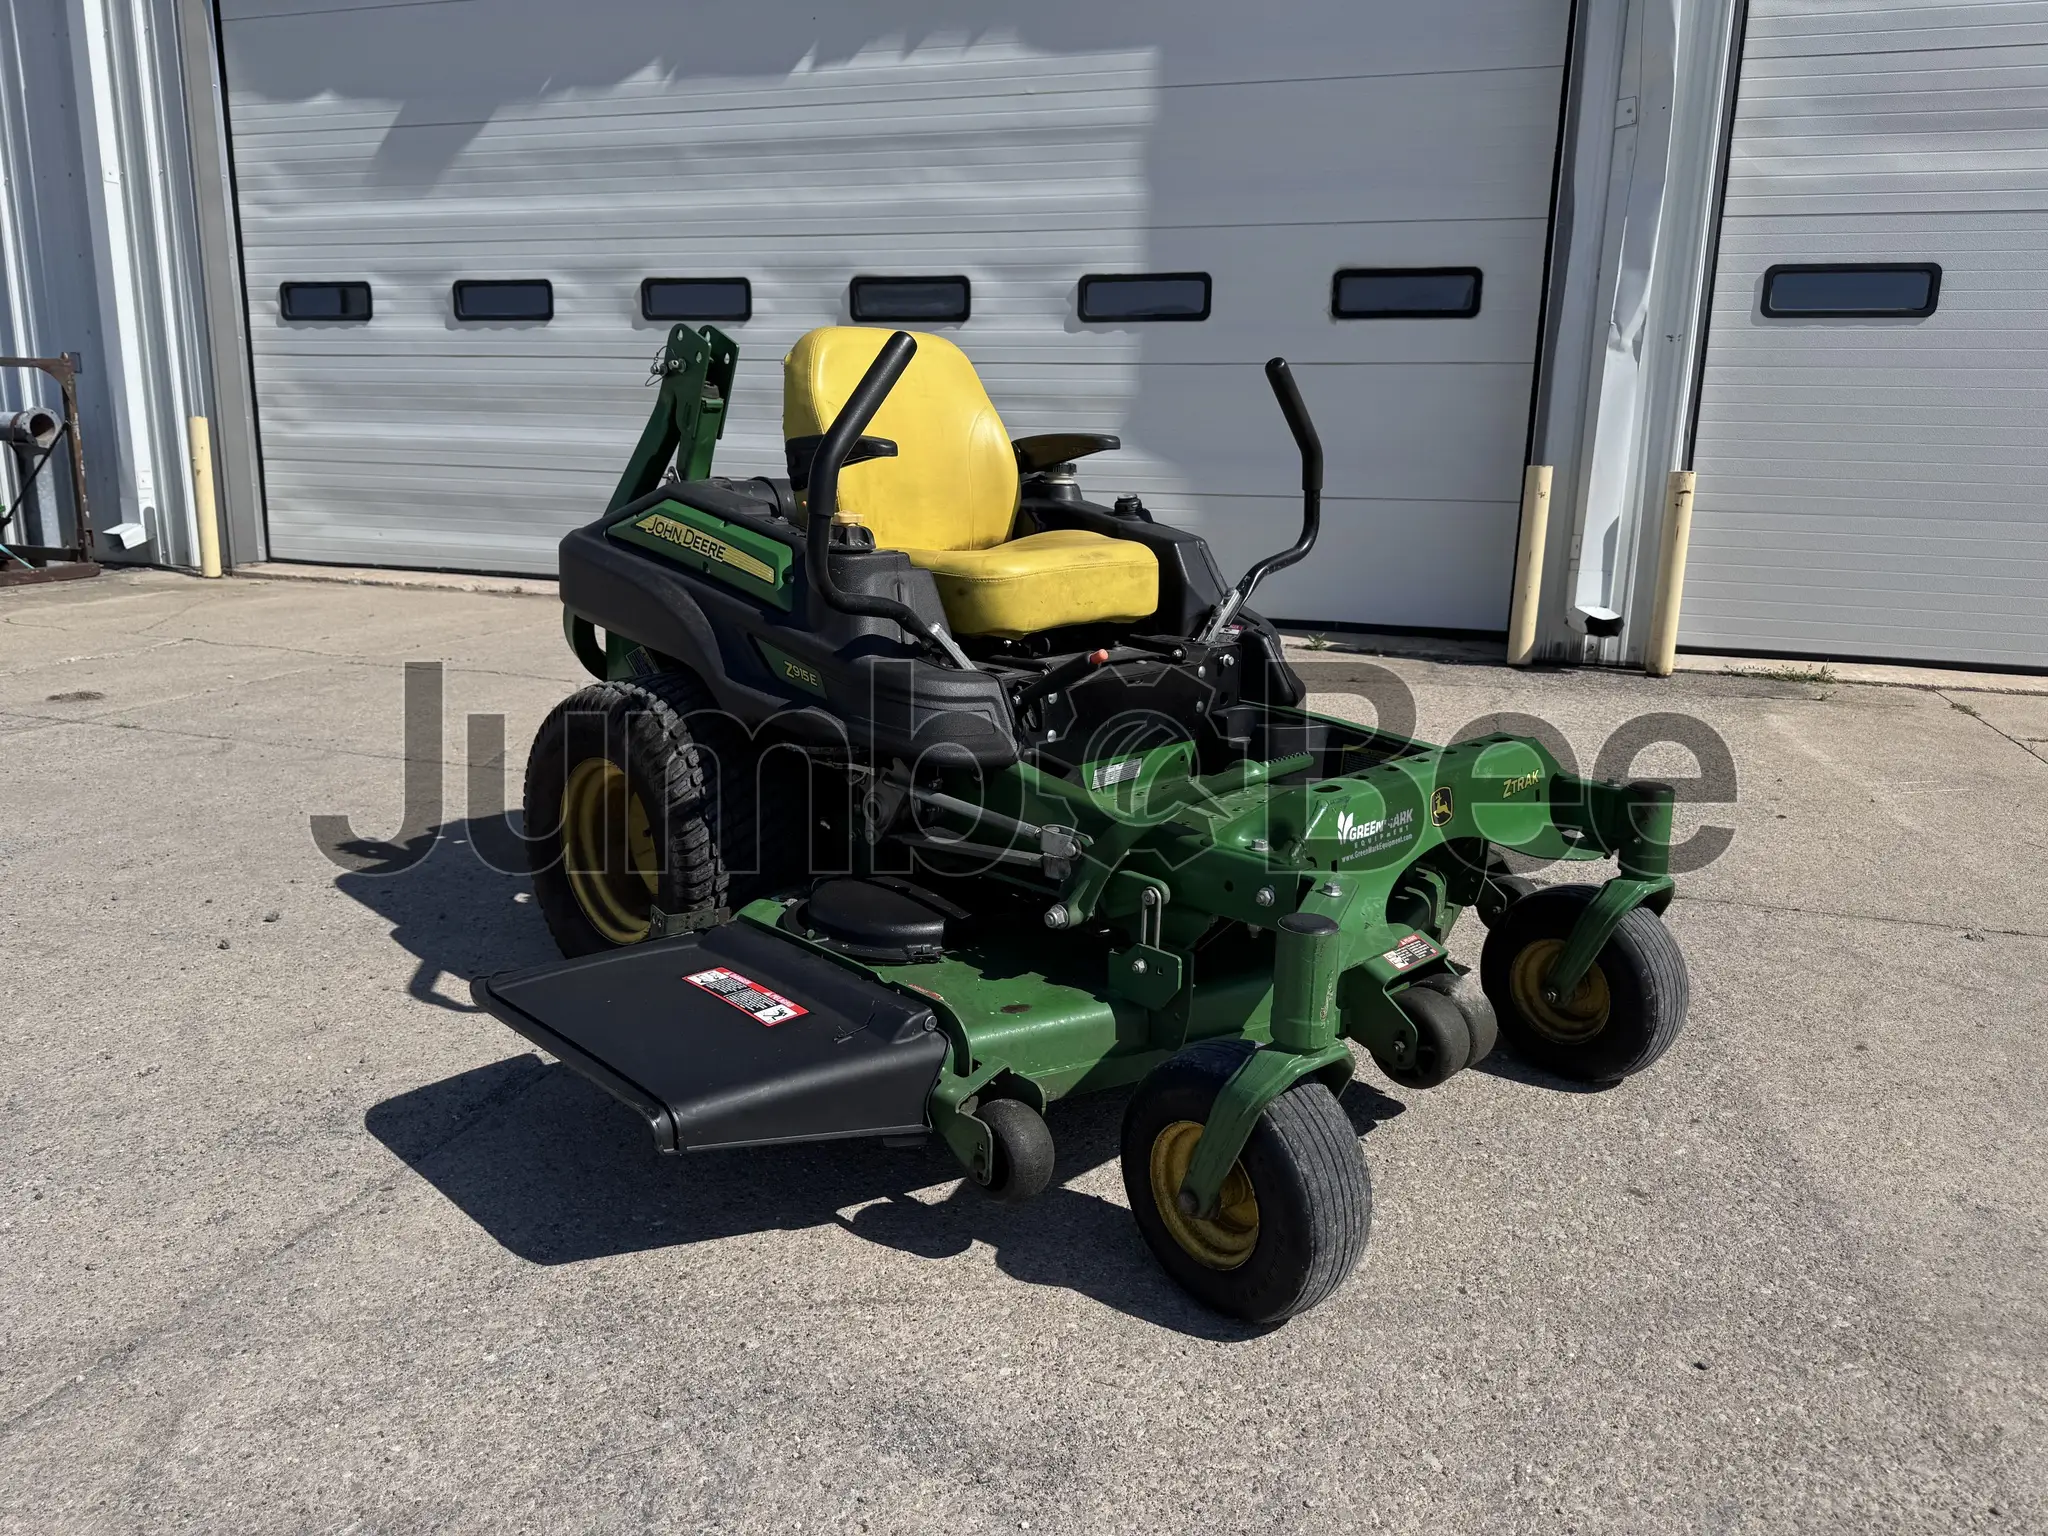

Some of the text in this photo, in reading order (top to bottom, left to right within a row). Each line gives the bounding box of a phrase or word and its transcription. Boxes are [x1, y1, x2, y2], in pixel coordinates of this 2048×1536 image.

[647, 516, 726, 561] JOHN DEERE
[784, 660, 818, 687] Z915E
